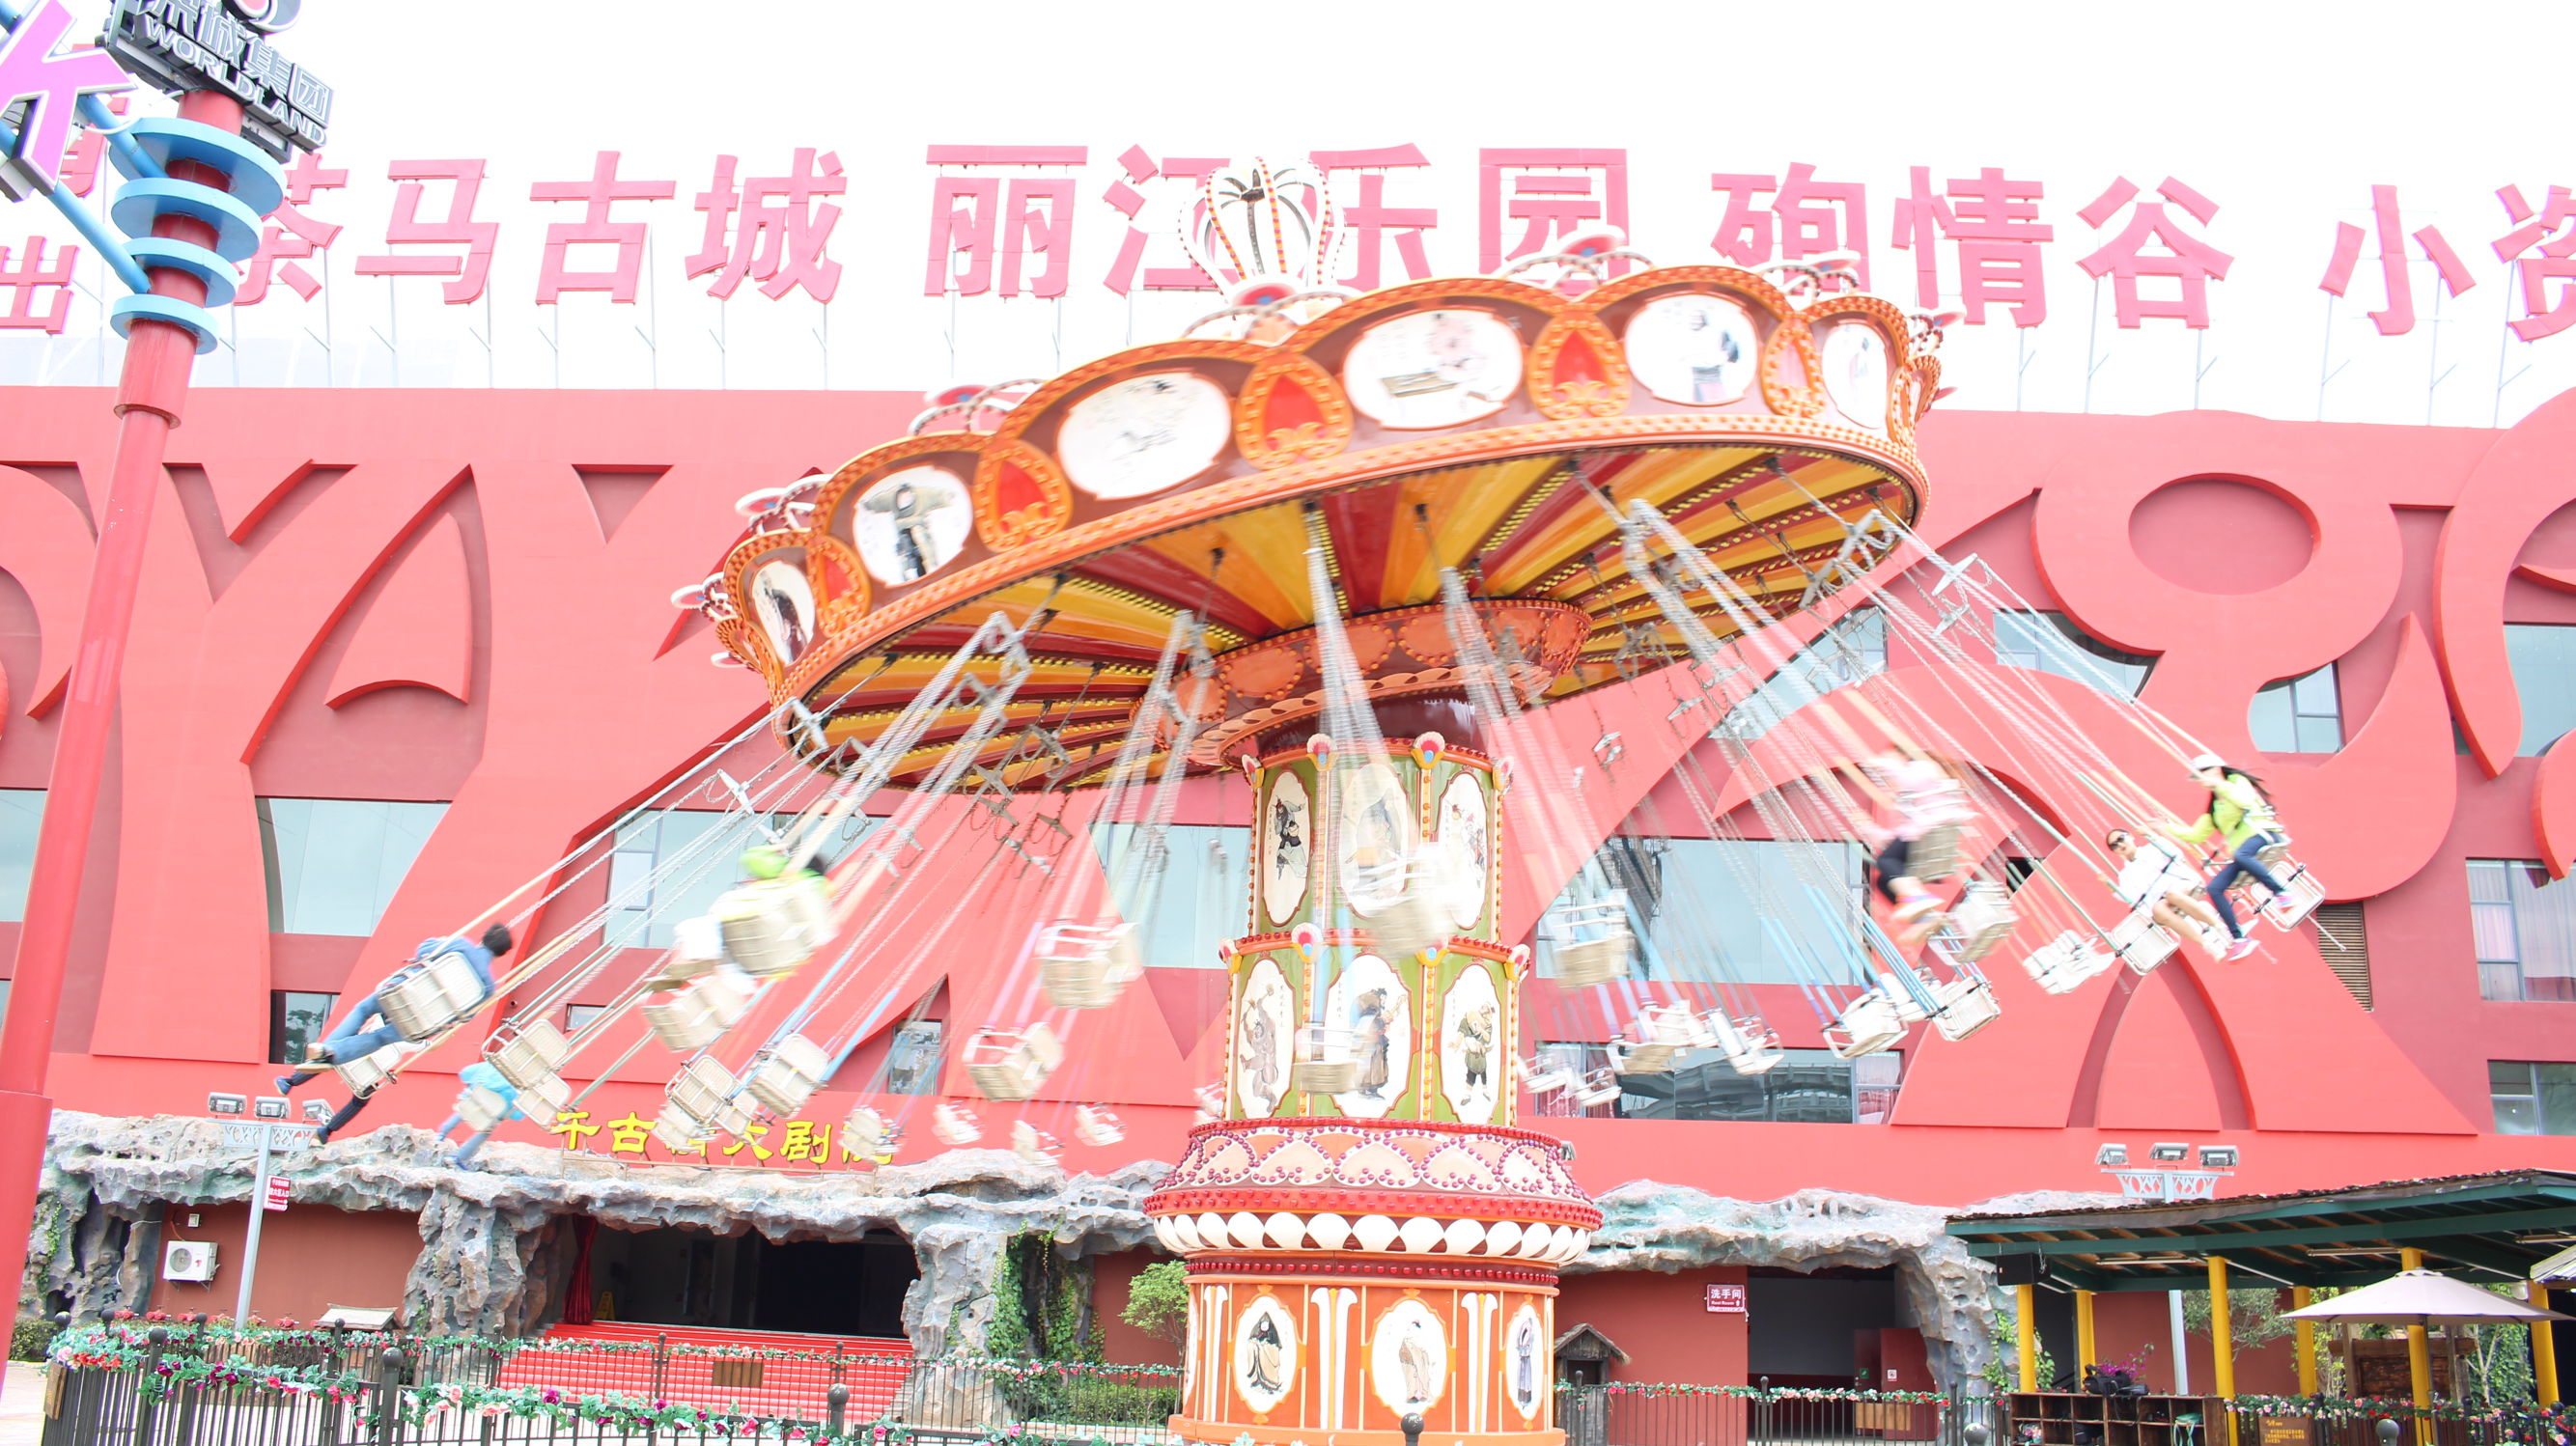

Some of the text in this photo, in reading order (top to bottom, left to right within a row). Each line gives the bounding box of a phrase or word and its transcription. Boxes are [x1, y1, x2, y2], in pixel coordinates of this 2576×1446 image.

[145, 14, 327, 150] WORLDLAND
[1710, 1289, 1742, 1299] 洗手间
